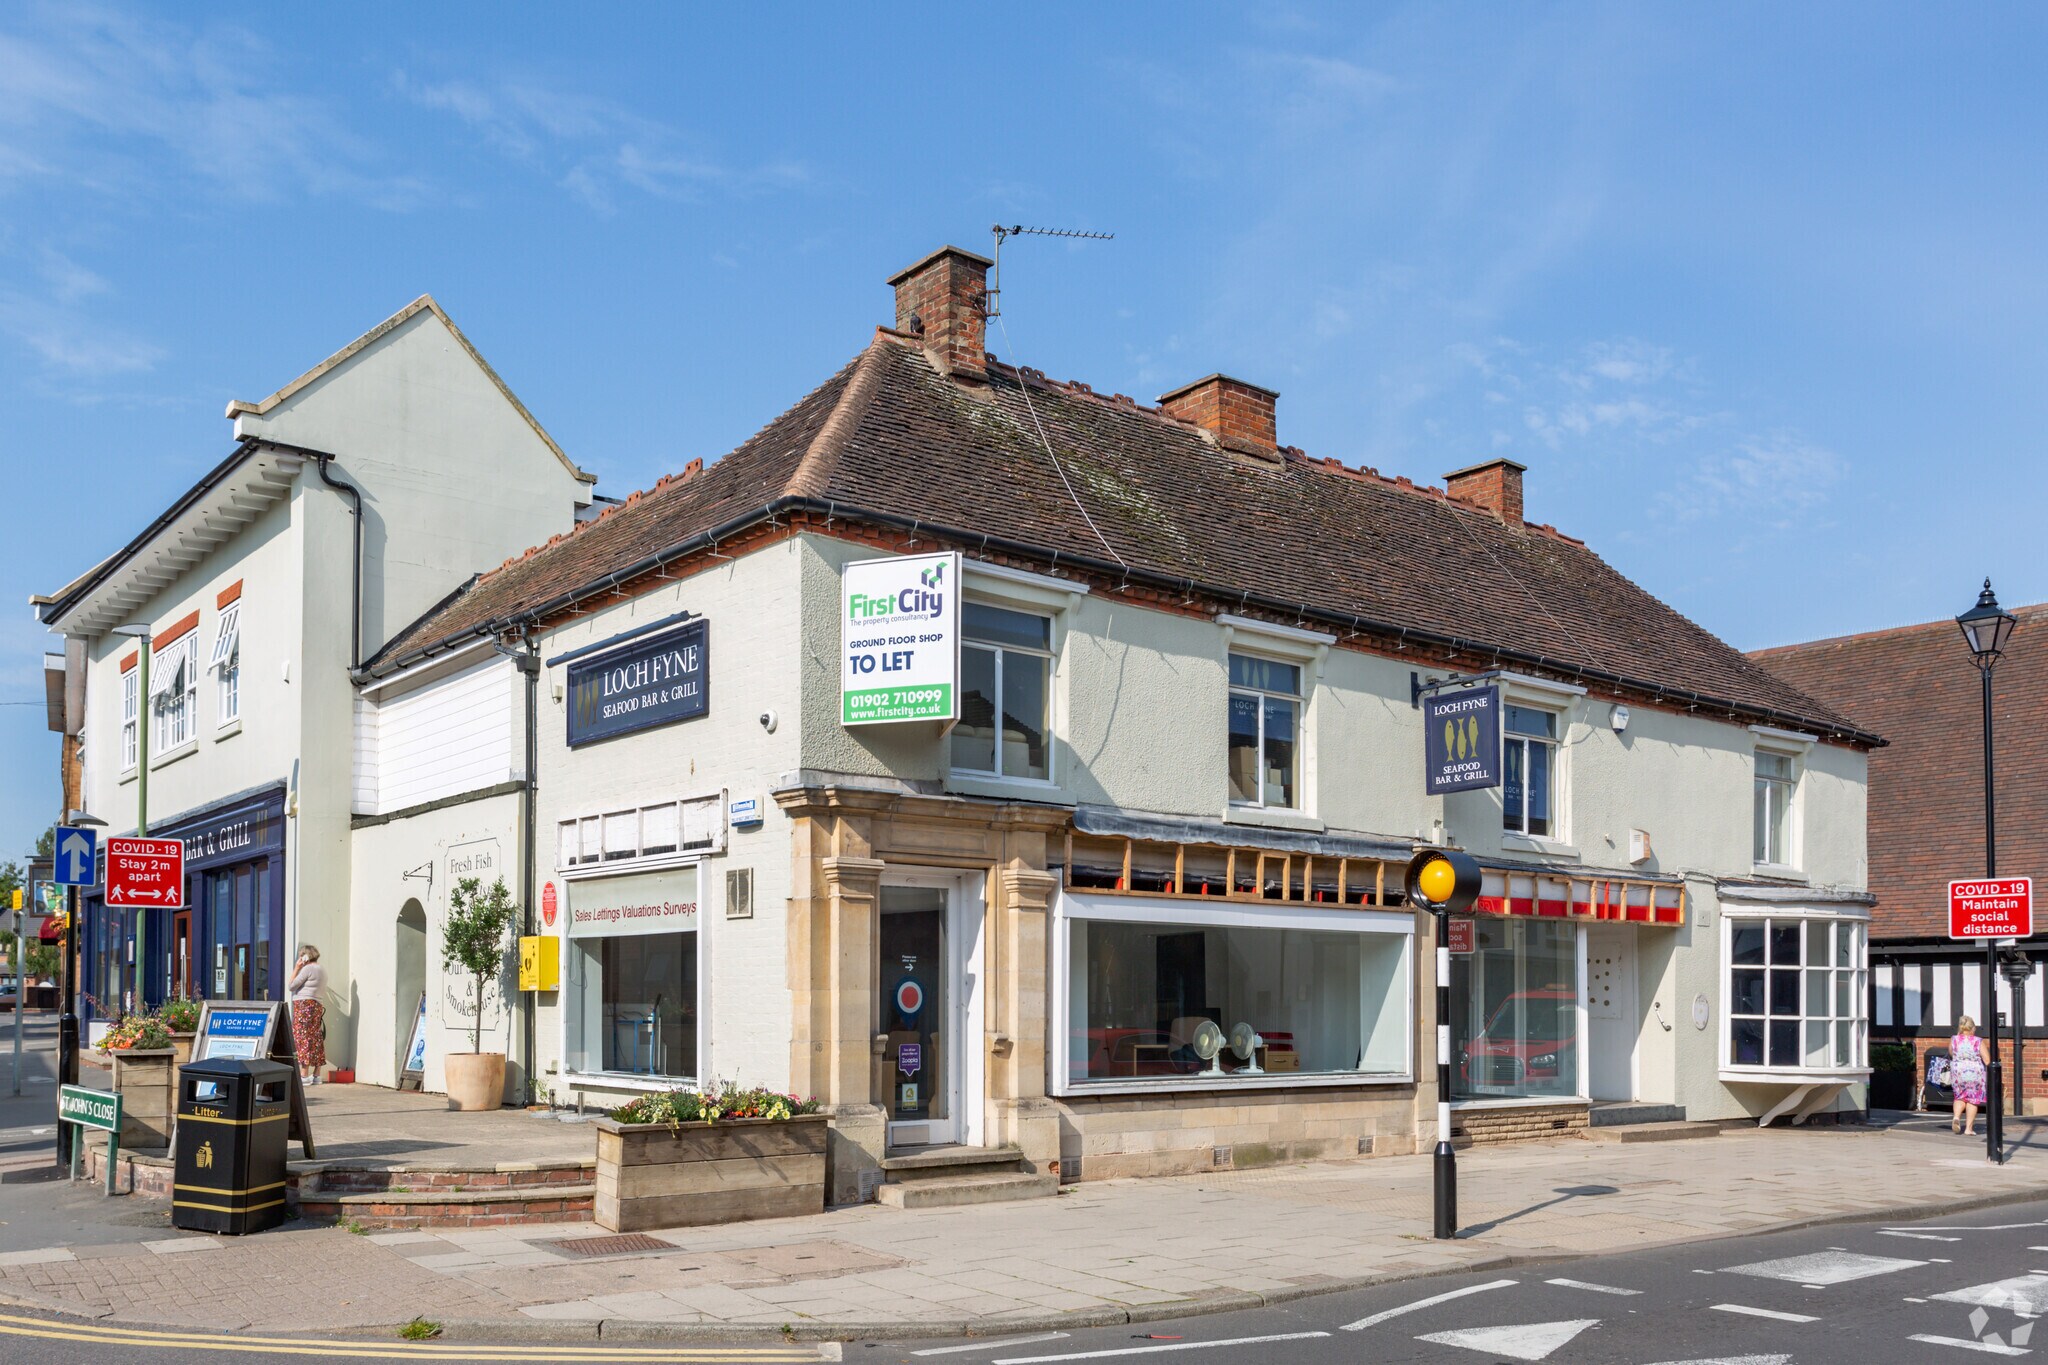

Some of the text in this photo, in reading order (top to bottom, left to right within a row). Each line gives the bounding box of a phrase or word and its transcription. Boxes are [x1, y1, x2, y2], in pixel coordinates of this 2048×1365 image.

[862, 617, 889, 627] property
[890, 613, 929, 623] consultancy
[850, 633, 943, 649] GROUND FLOOR SHOP
[850, 651, 914, 674] TO LET
[604, 644, 699, 697] LOCH FYNE
[603, 681, 699, 719] SEAFOOD BAR & GRILL
[851, 689, 942, 708] 01902 710999
[1235, 701, 1255, 710] LOCH
[851, 703, 941, 719] www.firstcity.co.uk
[1434, 697, 1488, 716] LOCH FYNE
[1443, 761, 1481, 775] SEAFOOD
[1435, 770, 1490, 785] BAR & GRILL
[1505, 785, 1520, 795] LOCH
[112, 842, 155, 854] COVID
[185, 821, 251, 861] BAR & GRILL
[119, 859, 147, 871] Stay
[450, 851, 492, 873] Fresh Fish
[128, 872, 161, 882] apart
[1955, 884, 2000, 896] COVID
[1962, 898, 2018, 910] Maintain
[575, 901, 697, 923] Sales Lettings Valuations Surveys
[1971, 911, 2009, 922] social
[1962, 924, 2018, 934] distance
[466, 980, 473, 997] &
[446, 985, 495, 1017] Smokehuse
[243, 1019, 262, 1027] FYNE
[93, 1102, 114, 1121] CLOSE
[194, 1106, 220, 1117] Litter
